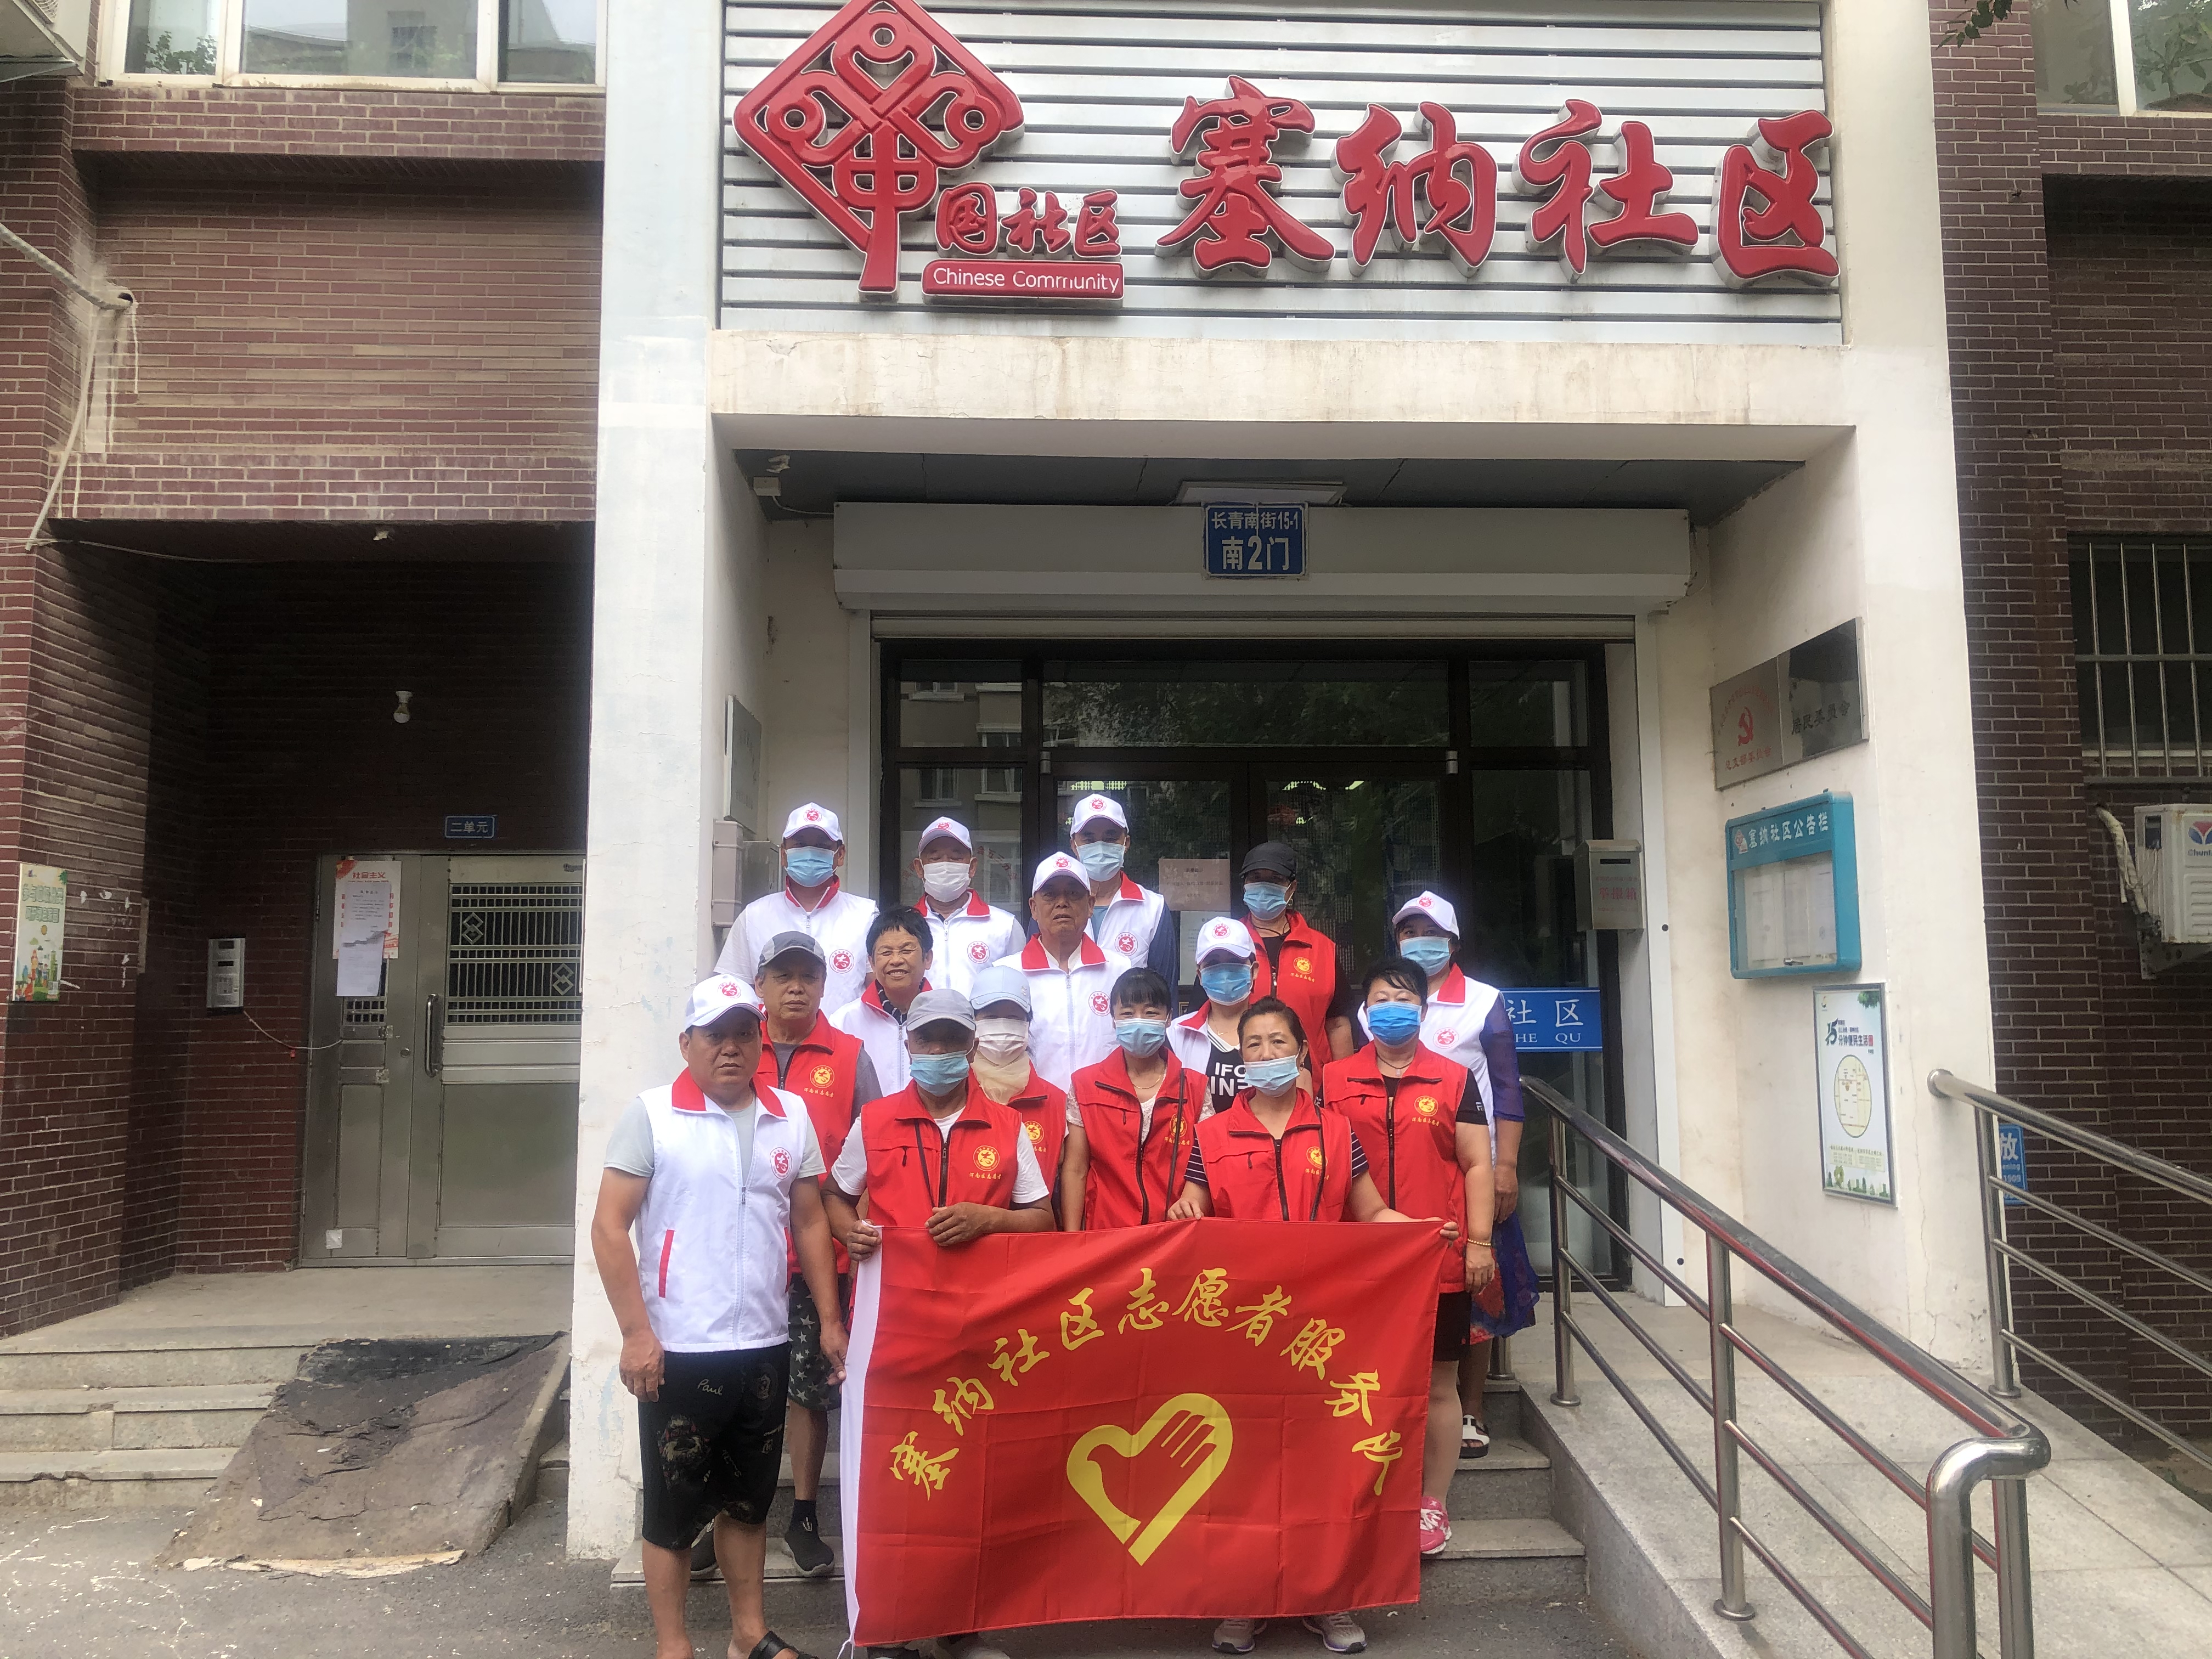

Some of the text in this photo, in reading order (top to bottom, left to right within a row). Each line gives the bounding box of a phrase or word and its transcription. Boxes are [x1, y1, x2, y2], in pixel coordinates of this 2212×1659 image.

[1156, 74, 1840, 281] 塞纳社区
[933, 267, 1119, 294] Chinese Community
[1222, 535, 1289, 571] 南2门
[450, 822, 489, 834] 二单元
[1506, 999, 1584, 1028] 社区
[1515, 1032, 1581, 1045] HE QU
[697, 1379, 723, 1396] Paul
[890, 1267, 1403, 1501] 塞纳社区志愿者服务队
